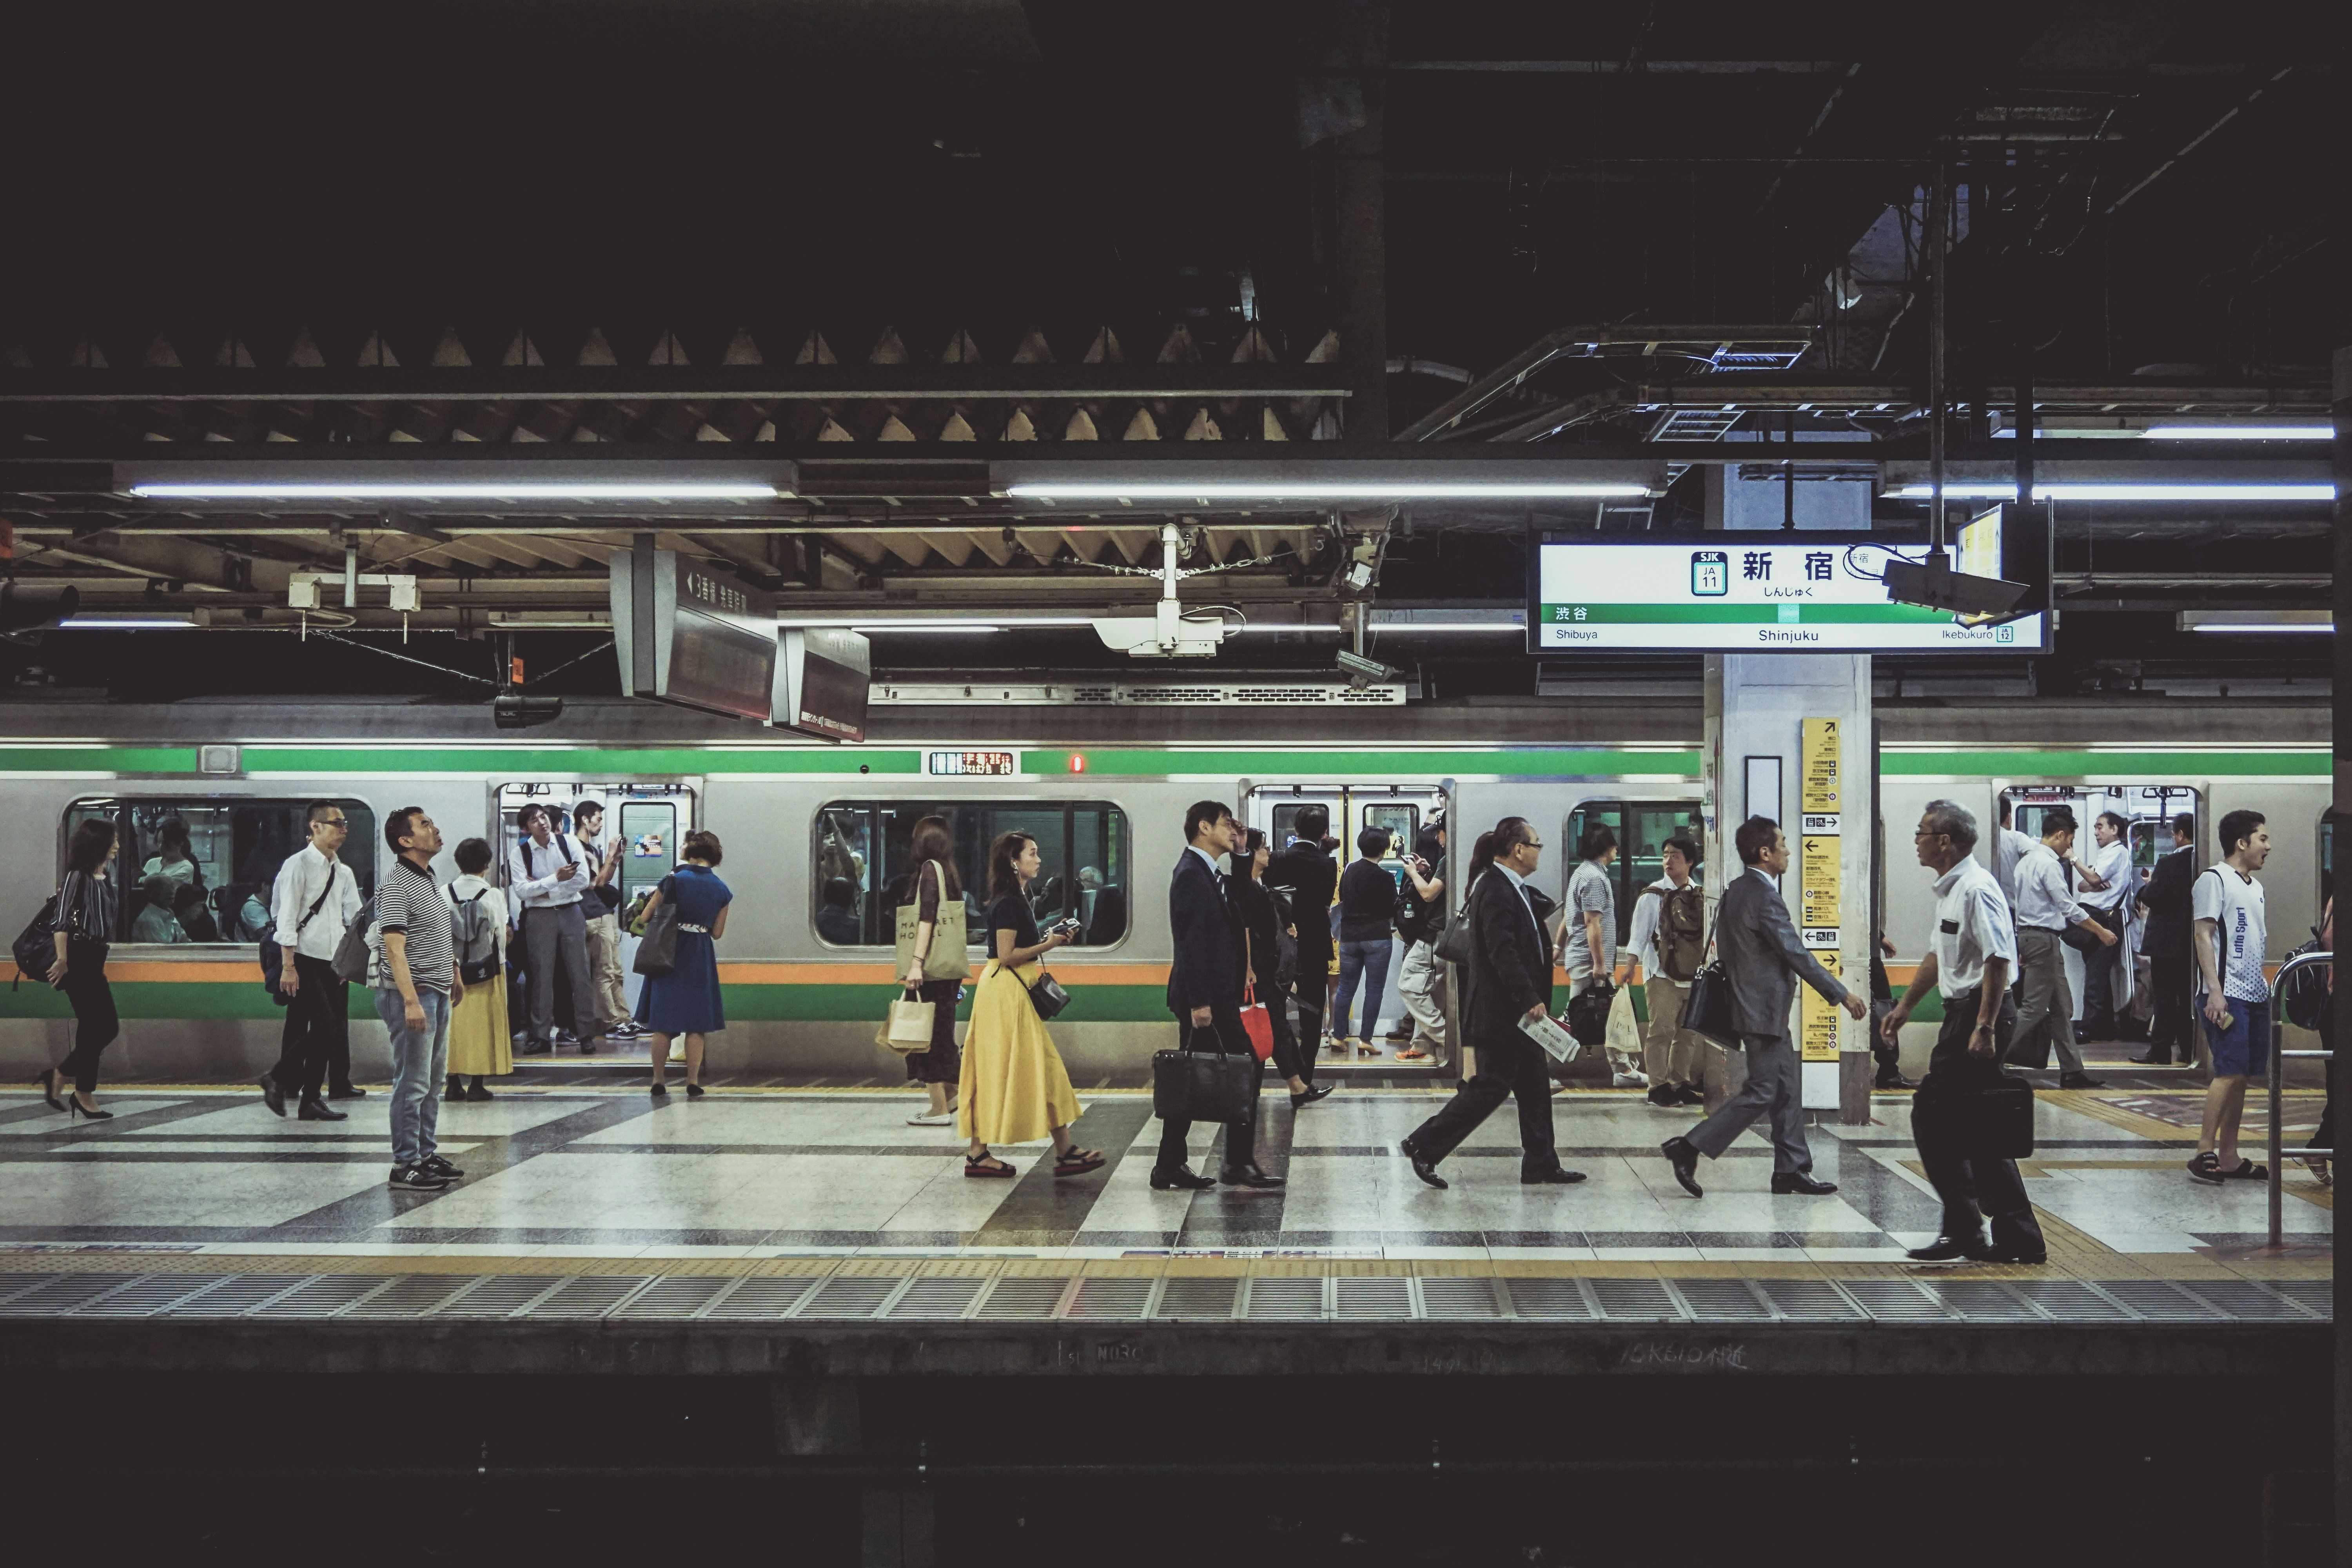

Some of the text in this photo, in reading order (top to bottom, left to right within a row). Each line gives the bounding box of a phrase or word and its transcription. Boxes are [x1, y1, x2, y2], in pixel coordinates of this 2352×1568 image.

[1700, 553, 1719, 562] SJK
[1704, 567, 1715, 575] JA
[1743, 551, 1833, 581] 新宿
[1702, 577, 1717, 587] 11
[1764, 587, 1813, 597] しんじゅく
[1556, 606, 1587, 620] 渋谷
[1556, 629, 1597, 641] Shibuya
[1759, 630, 1818, 644] Shinjuku
[1942, 630, 1993, 639] Ikebukuro
[901, 917, 953, 929] MARET
[2233, 907, 2248, 959] Lotto Sport
